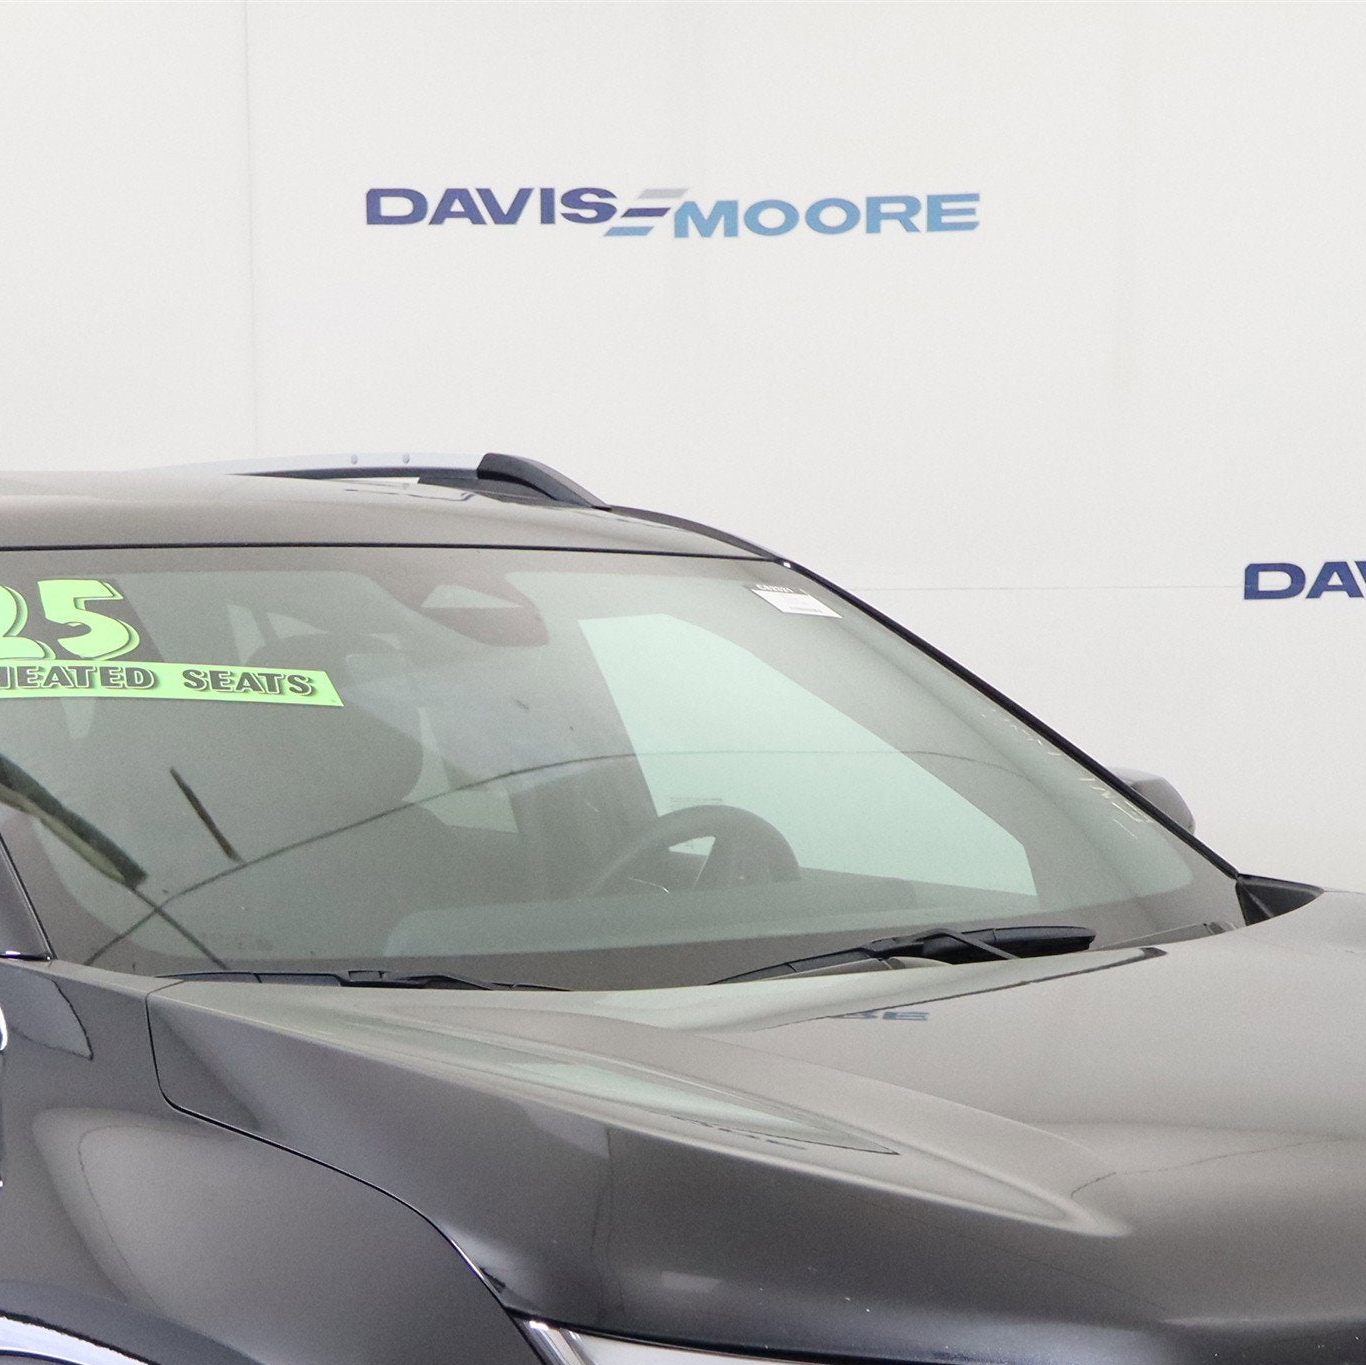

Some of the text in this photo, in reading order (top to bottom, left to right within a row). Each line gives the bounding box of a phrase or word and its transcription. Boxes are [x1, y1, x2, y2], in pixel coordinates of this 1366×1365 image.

[365, 186, 980, 238] DAVIS MOORE
[181, 668, 317, 697] SEATS
